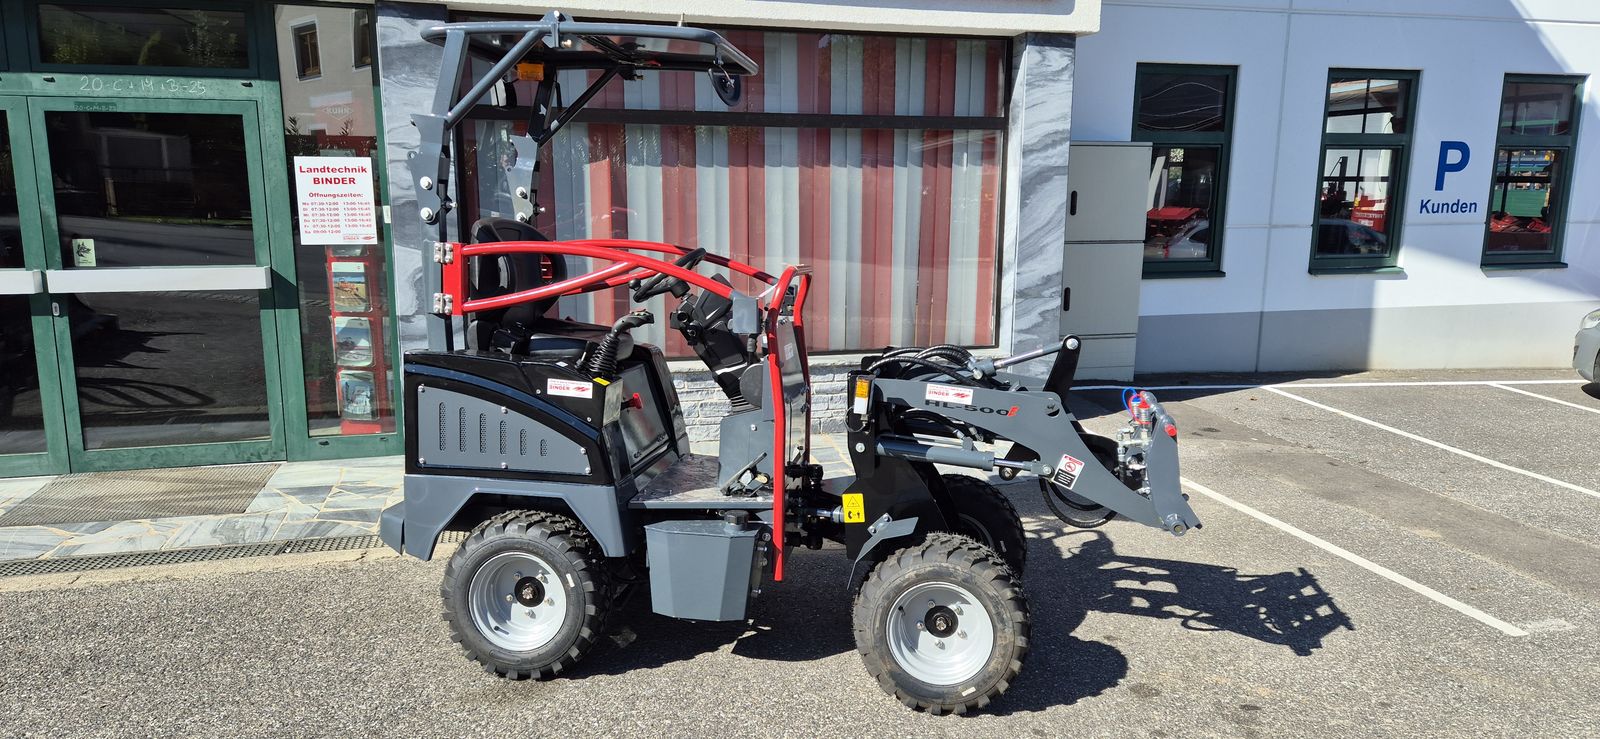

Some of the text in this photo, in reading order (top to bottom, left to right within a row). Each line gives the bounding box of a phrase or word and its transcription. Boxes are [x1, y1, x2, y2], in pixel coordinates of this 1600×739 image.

[299, 165, 368, 174] Landtechnik
[1434, 140, 1471, 192] P
[313, 177, 356, 185] BINDER
[1419, 199, 1478, 214] Kunden
